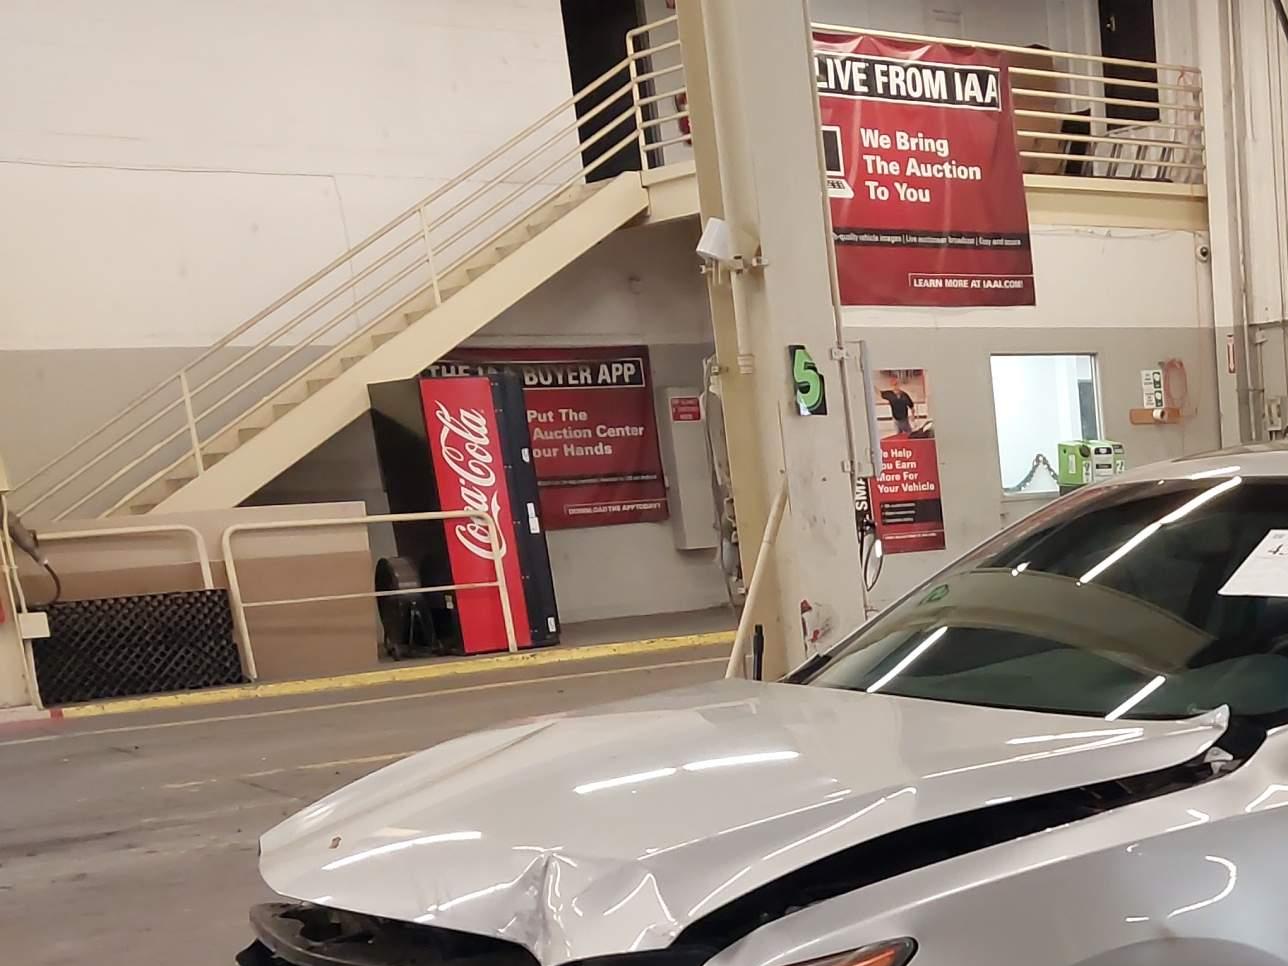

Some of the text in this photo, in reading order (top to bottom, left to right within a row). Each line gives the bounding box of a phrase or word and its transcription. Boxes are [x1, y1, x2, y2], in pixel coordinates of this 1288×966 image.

[815, 57, 869, 93] LIVE
[874, 63, 949, 100] FROM
[860, 127, 951, 158] We Bring
[863, 154, 982, 181] The Auction
[864, 180, 931, 203] To You
[913, 278, 943, 288] LEARN
[944, 279, 969, 289] MORE
[970, 279, 982, 289] AT
[524, 365, 592, 385] BUYER
[597, 363, 636, 384] APP
[793, 349, 822, 411] 5
[527, 408, 588, 423] Put The
[533, 425, 645, 441] Auction Center
[532, 442, 613, 459] our Hands
[890, 447, 912, 460] Help
[895, 460, 917, 470] Earn
[903, 471, 919, 481] For
[877, 481, 935, 494] Your Vehicle
